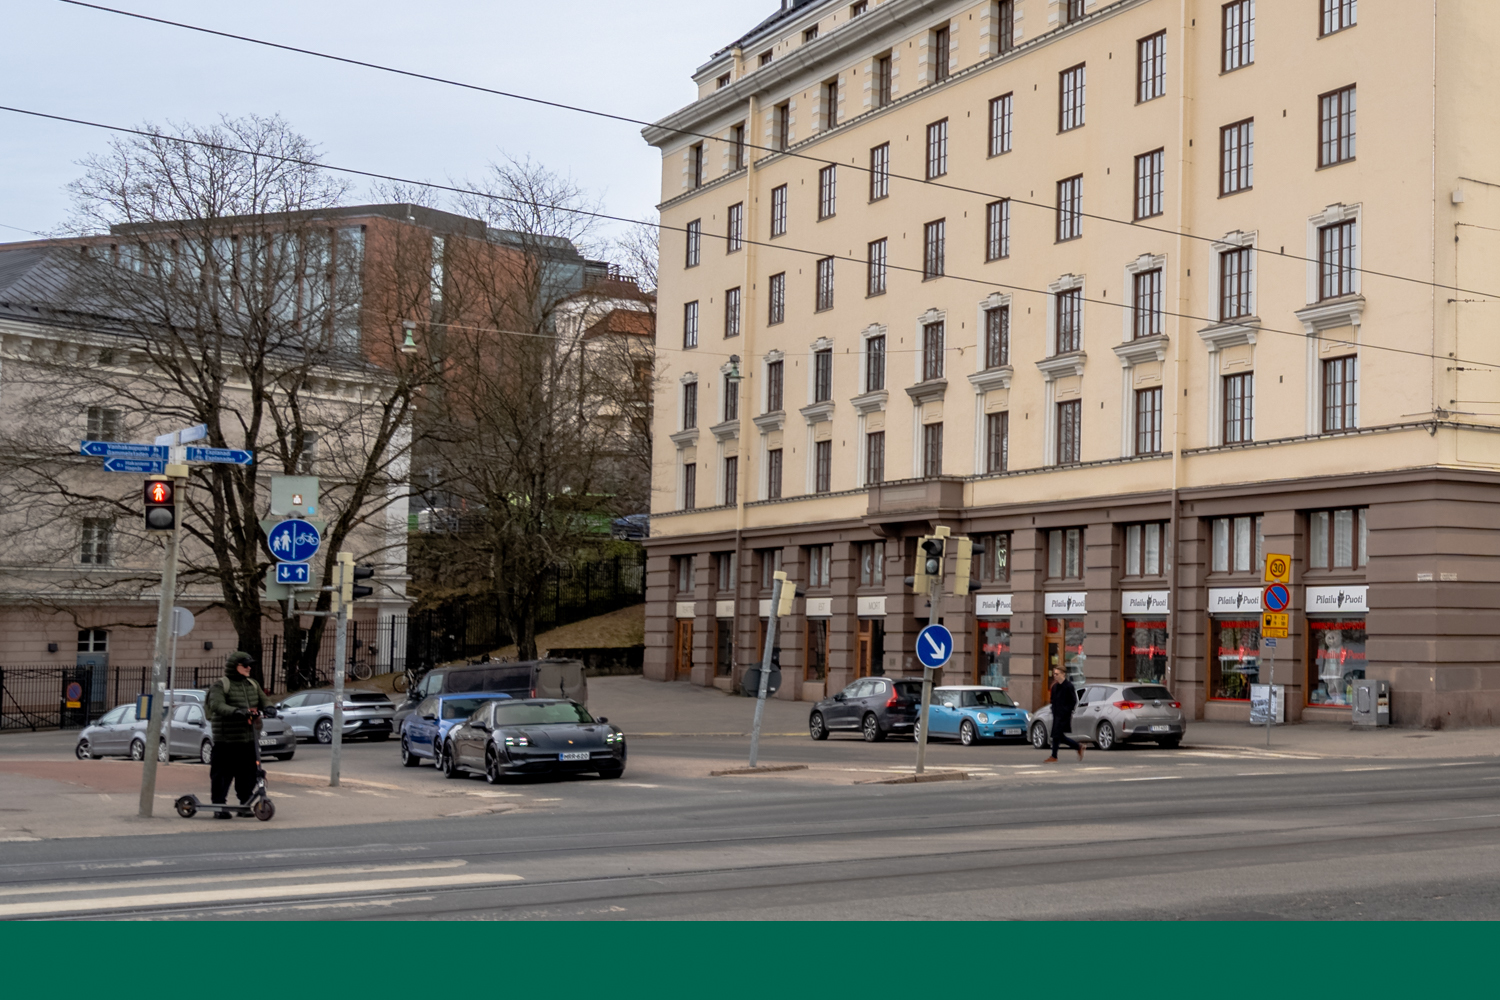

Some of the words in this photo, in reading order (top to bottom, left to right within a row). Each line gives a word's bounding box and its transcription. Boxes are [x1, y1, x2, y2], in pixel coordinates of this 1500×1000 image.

[107, 444, 150, 452] Vanhakaupunki
[1272, 563, 1283, 573] 30
[1051, 599, 1067, 608] Pilailu
[1129, 598, 1147, 606] Pilailu
[1152, 598, 1167, 607] Puoti
[1217, 596, 1237, 605] Pilailu
[1243, 596, 1259, 605] Puoti
[1316, 595, 1337, 604] Pilailu
[1344, 595, 1363, 604] Puoti
